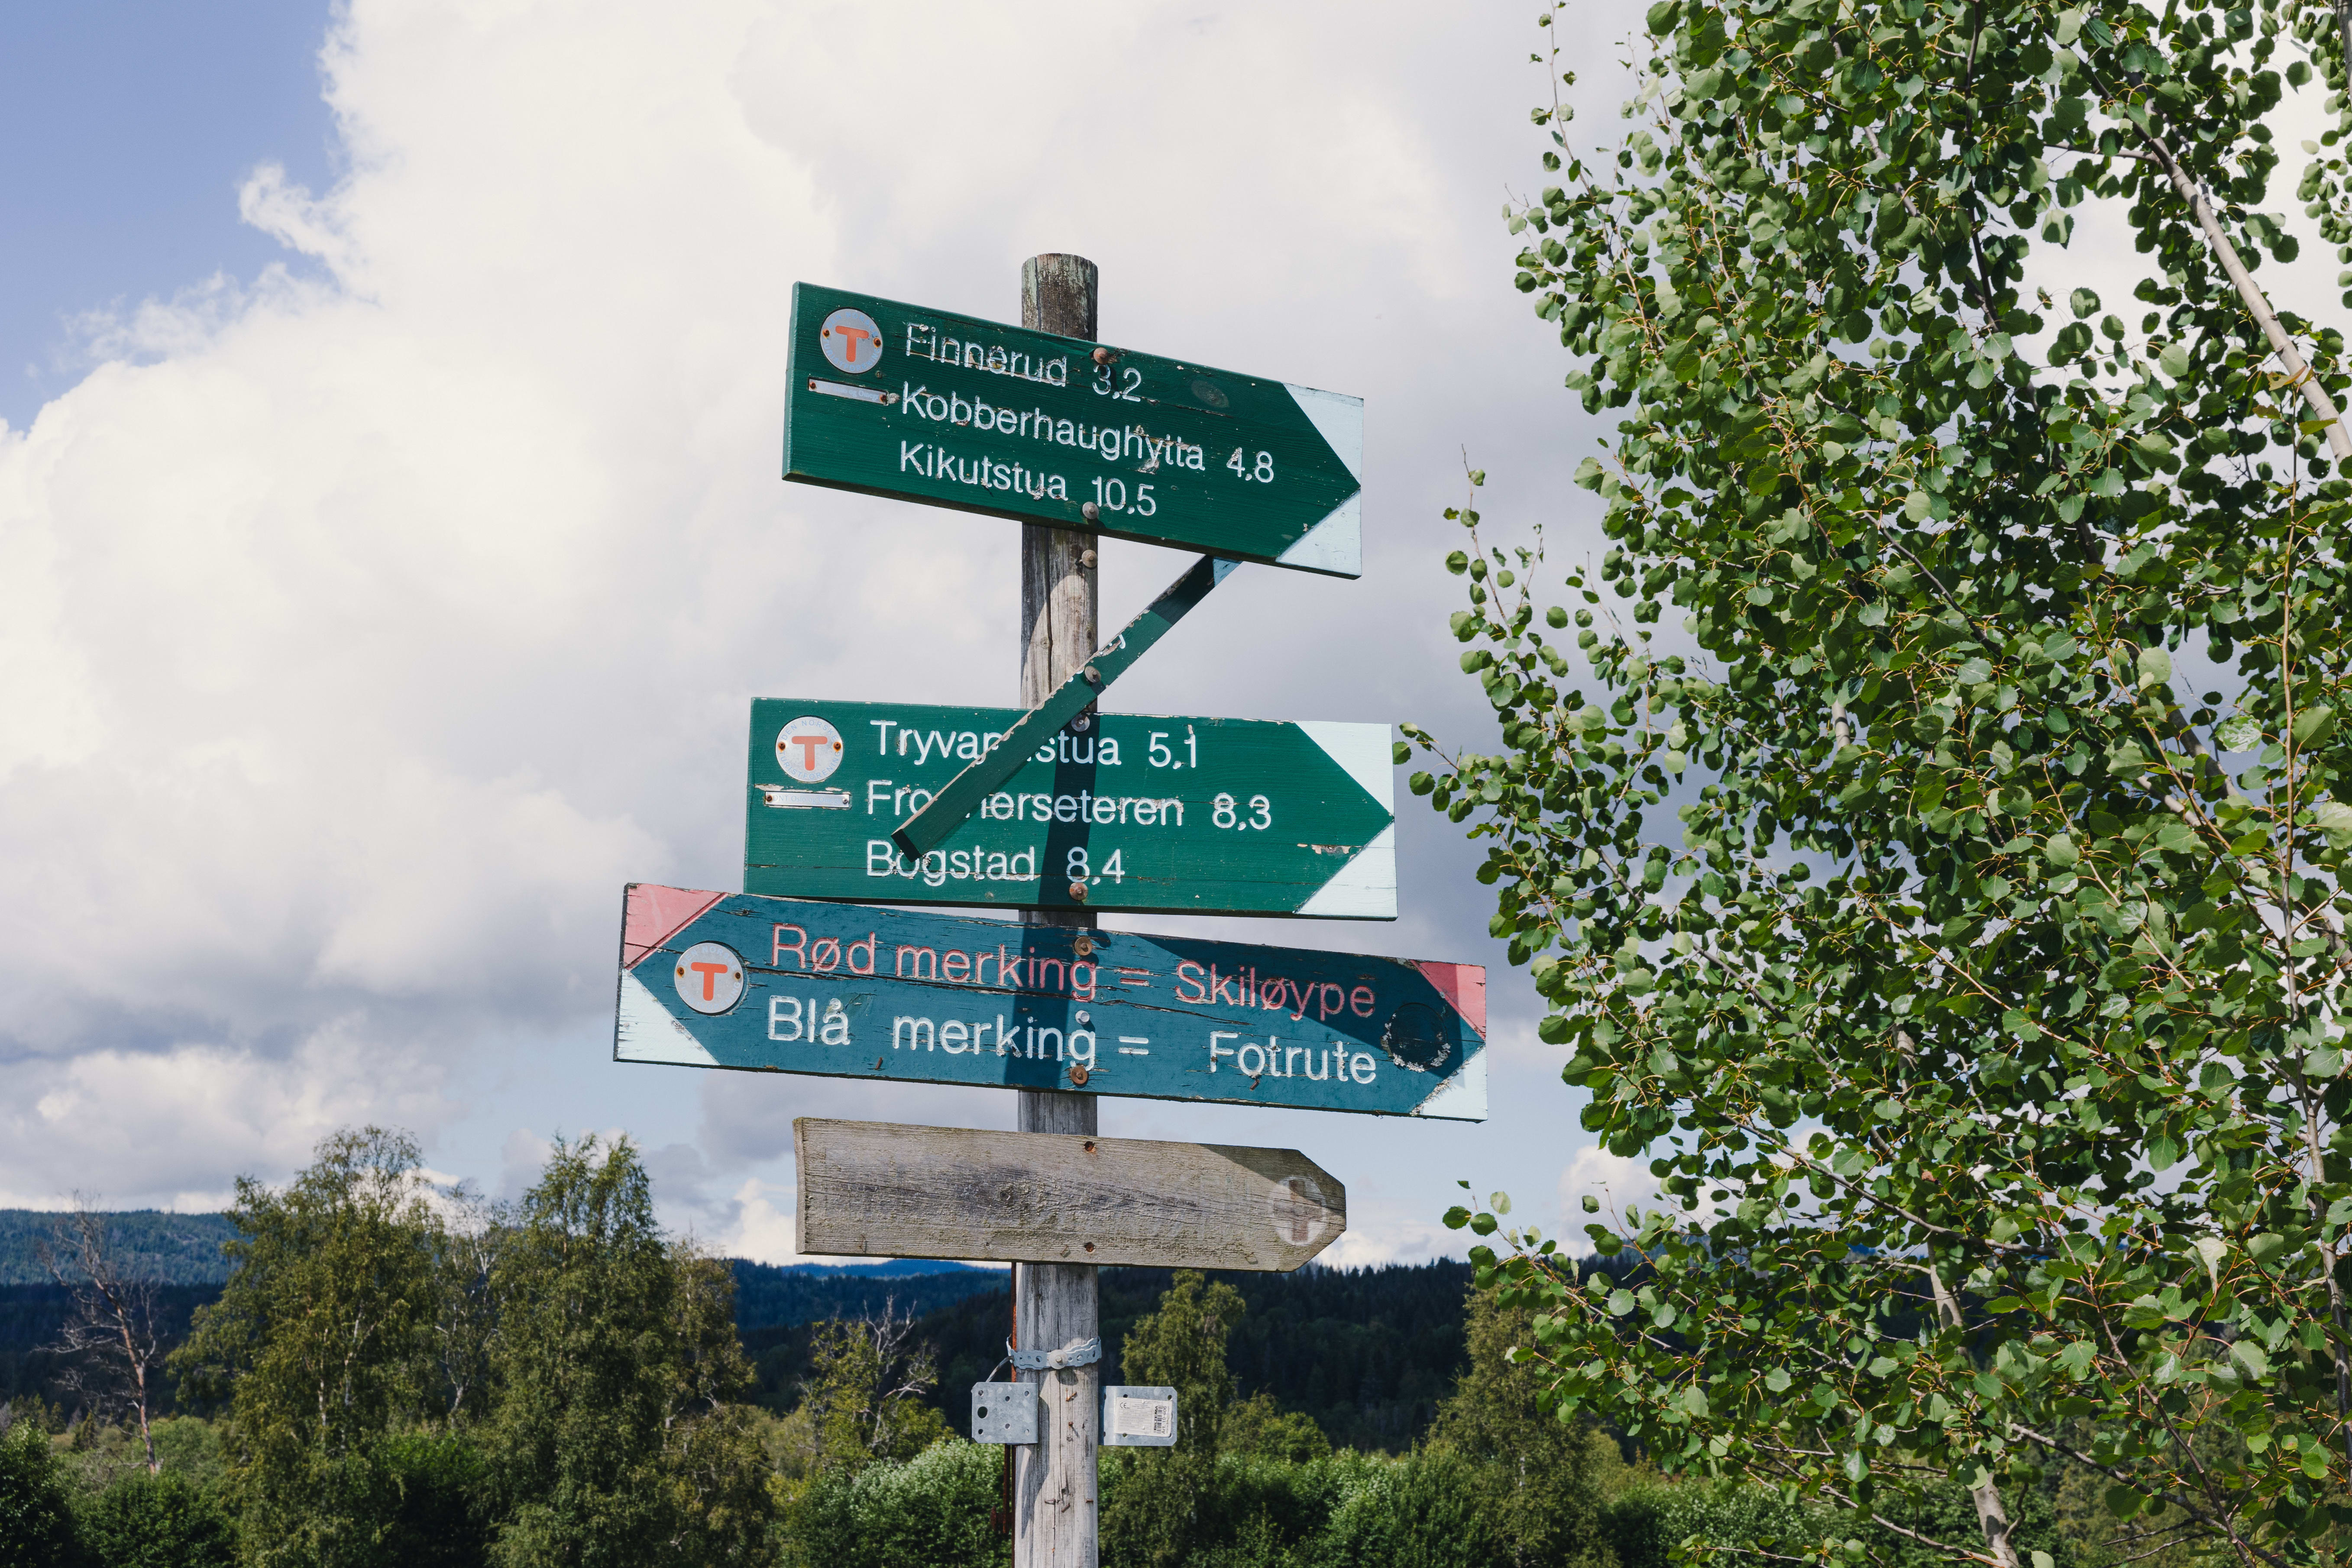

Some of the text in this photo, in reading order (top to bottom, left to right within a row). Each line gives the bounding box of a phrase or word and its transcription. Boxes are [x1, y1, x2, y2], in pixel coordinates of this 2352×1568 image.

[835, 325, 869, 362] T
[905, 323, 1142, 402] Finnerud 3,2
[901, 381, 1275, 483] Kobberhaughytta 4,8
[900, 440, 1157, 517] Kikutstua 10,5
[781, 720, 838, 742] DEN NORSKE
[791, 736, 828, 771] T
[870, 720, 1198, 769] Tryvanstua 5,1
[780, 750, 841, 780] TURISTFORENING
[867, 780, 1272, 831] Froerseteren 8,3
[867, 839, 1125, 887] Bogstad 8,4
[690, 962, 728, 1001] T
[772, 923, 875, 975] Rød
[896, 944, 1097, 1001] merking
[1175, 961, 1374, 1021] Skiløype
[768, 995, 851, 1045] Blå
[893, 1014, 1096, 1071] merking
[1210, 1031, 1376, 1084] Fotrute
